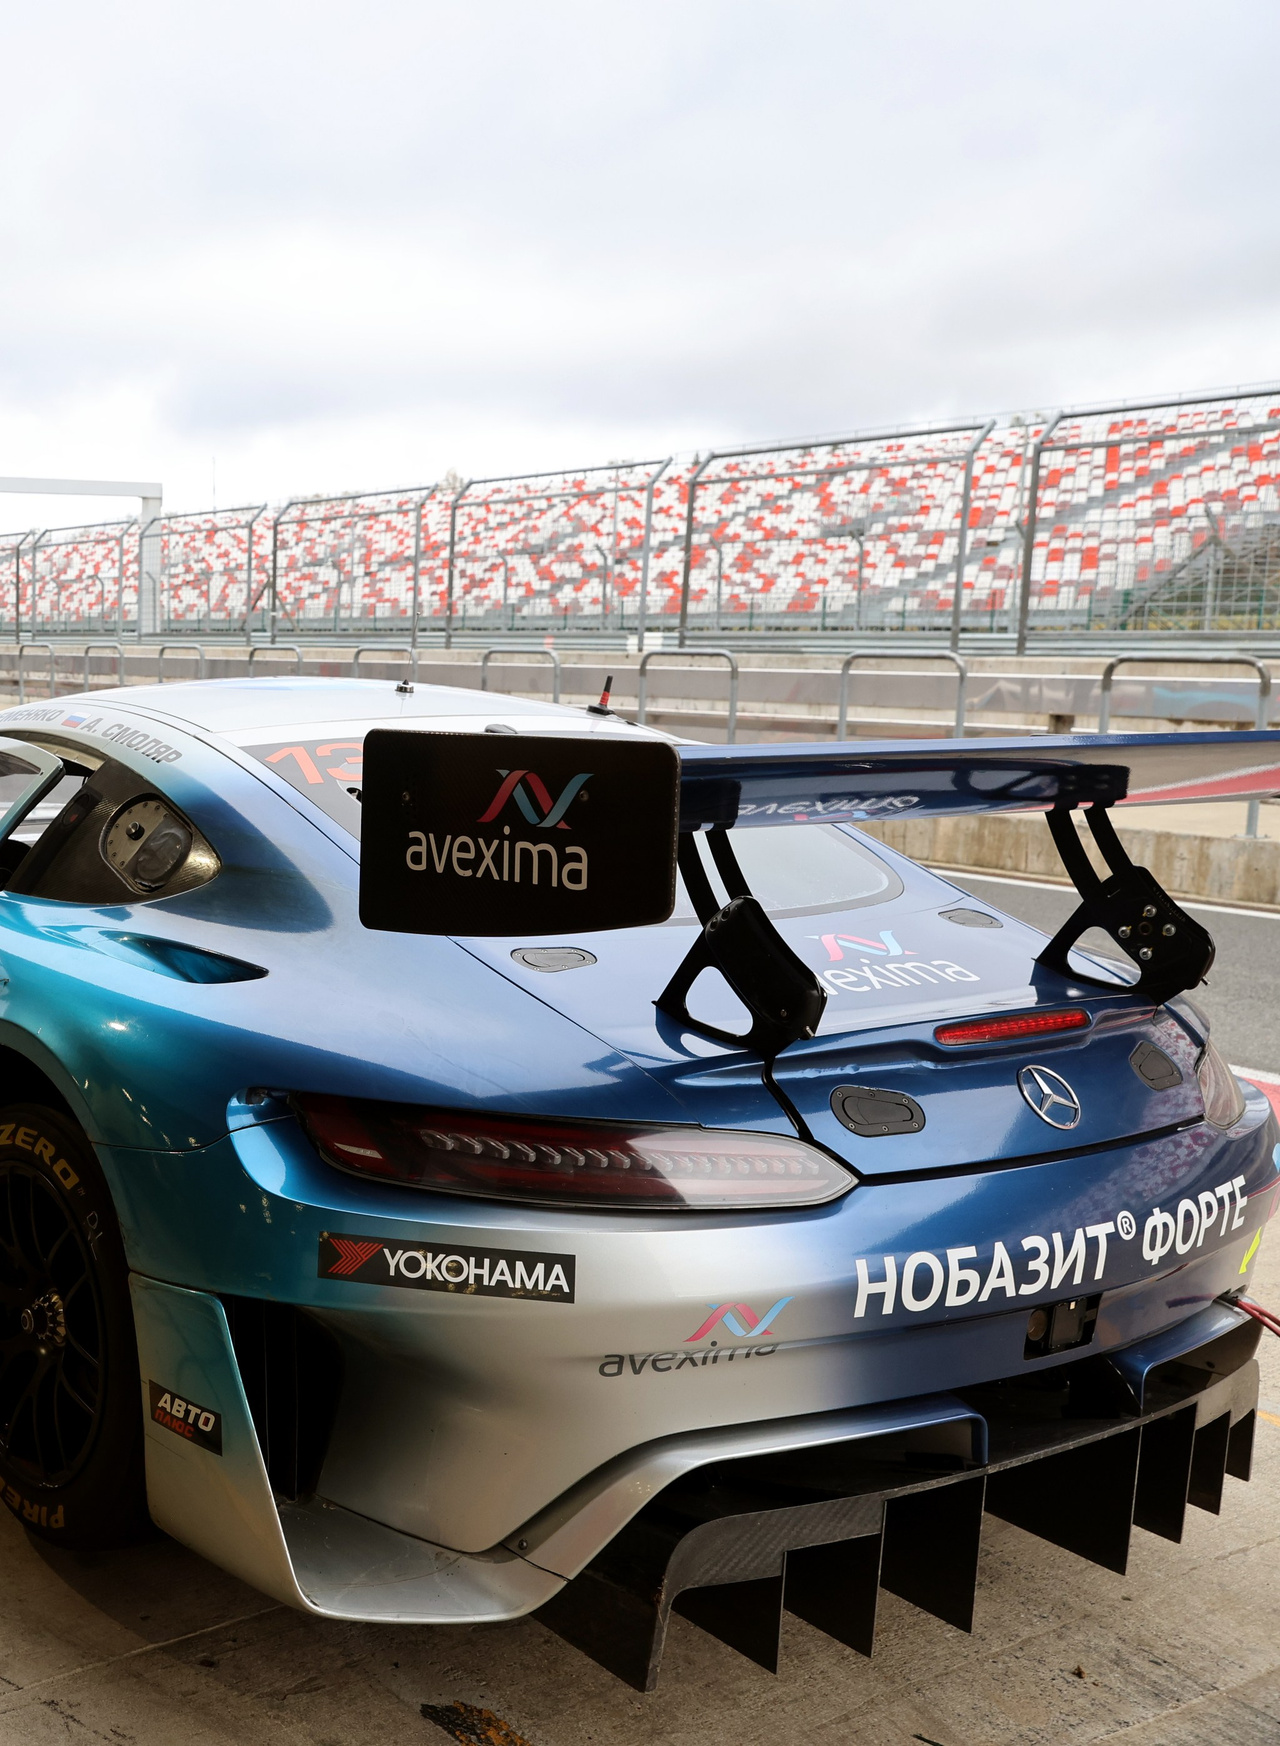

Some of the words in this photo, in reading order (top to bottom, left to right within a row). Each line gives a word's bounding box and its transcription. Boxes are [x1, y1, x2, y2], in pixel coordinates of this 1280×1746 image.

[101, 723, 183, 764] СМОЛЯР
[264, 742, 363, 785] 13
[405, 825, 588, 891] avexima
[1142, 1174, 1248, 1265] ФОРТЕ
[383, 1248, 570, 1293] YOKOHAMA
[154, 1408, 195, 1438] ПЛЮС
[157, 1392, 216, 1432] АВТО
